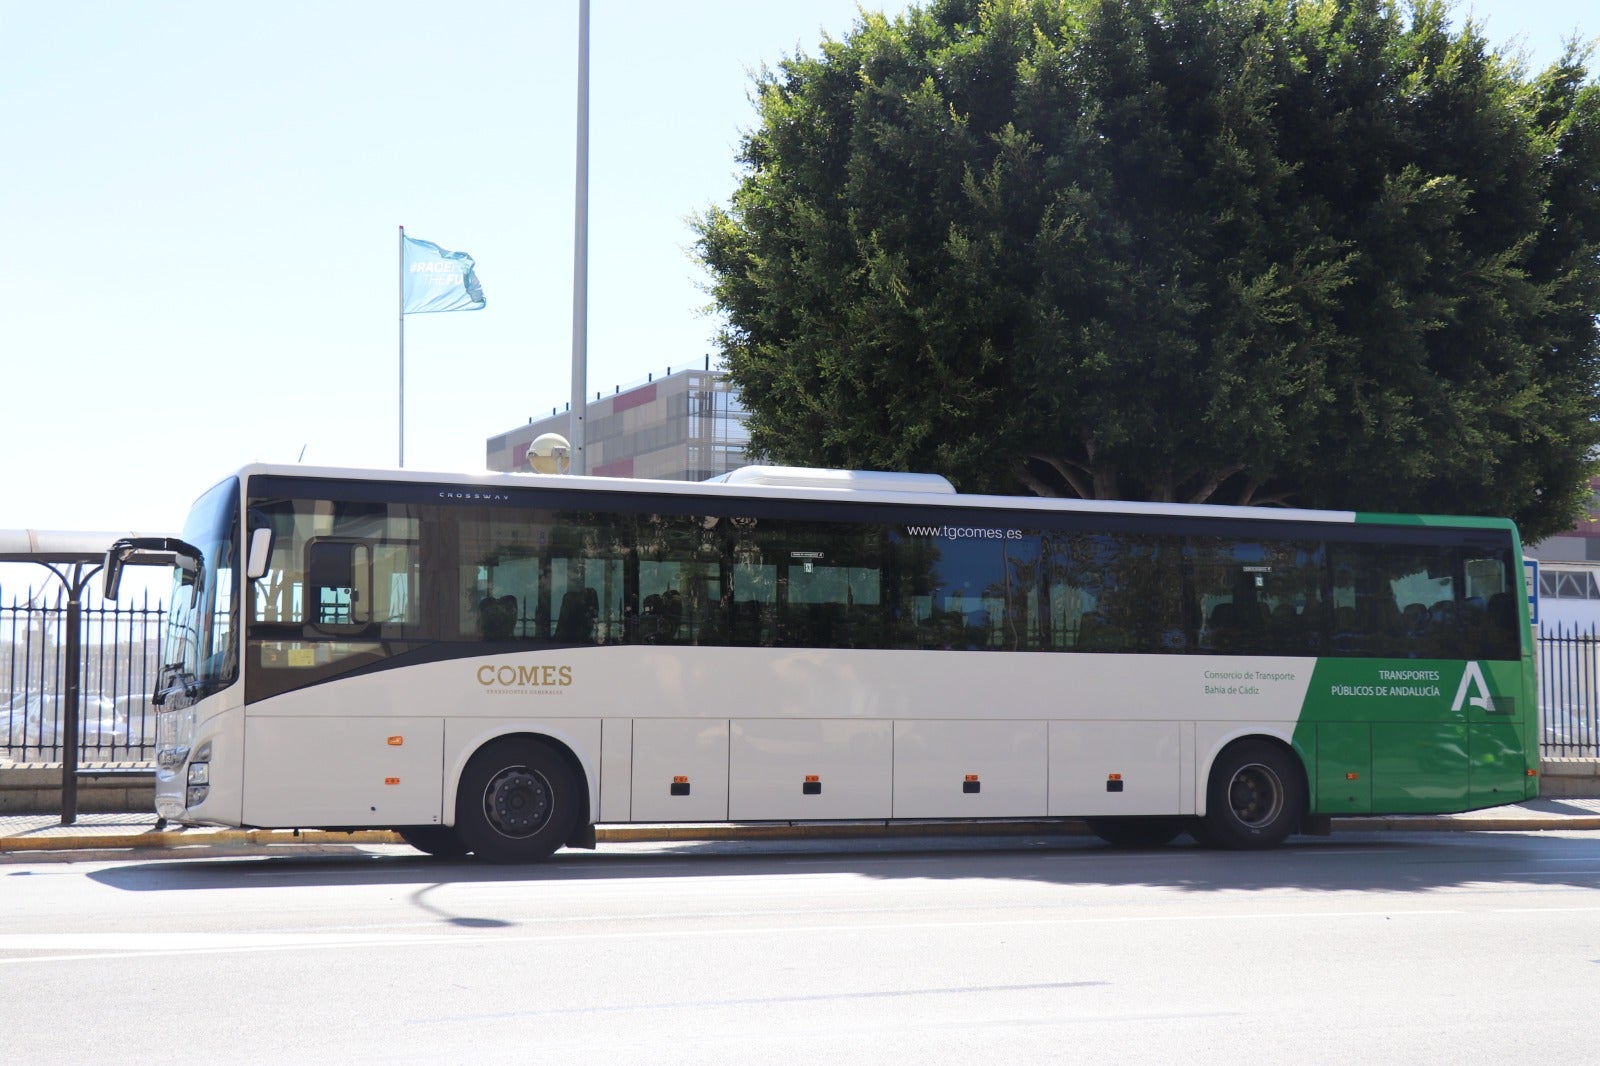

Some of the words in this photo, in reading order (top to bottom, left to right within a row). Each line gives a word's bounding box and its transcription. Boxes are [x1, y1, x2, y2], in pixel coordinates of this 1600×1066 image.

[439, 492, 509, 500] CROSSWAY
[907, 525, 1023, 540] www.tgcomes.es
[477, 665, 573, 686] COMES
[1204, 670, 1242, 680] Consorcio
[1244, 671, 1254, 680] de
[1256, 671, 1295, 682] Transporte
[1379, 670, 1440, 681] TRANSPORTES
[1227, 685, 1237, 694] de
[1331, 685, 1374, 696] PÚBLICOS
[1376, 686, 1388, 696] DE
[1389, 685, 1440, 697] ANDALUCÍA
